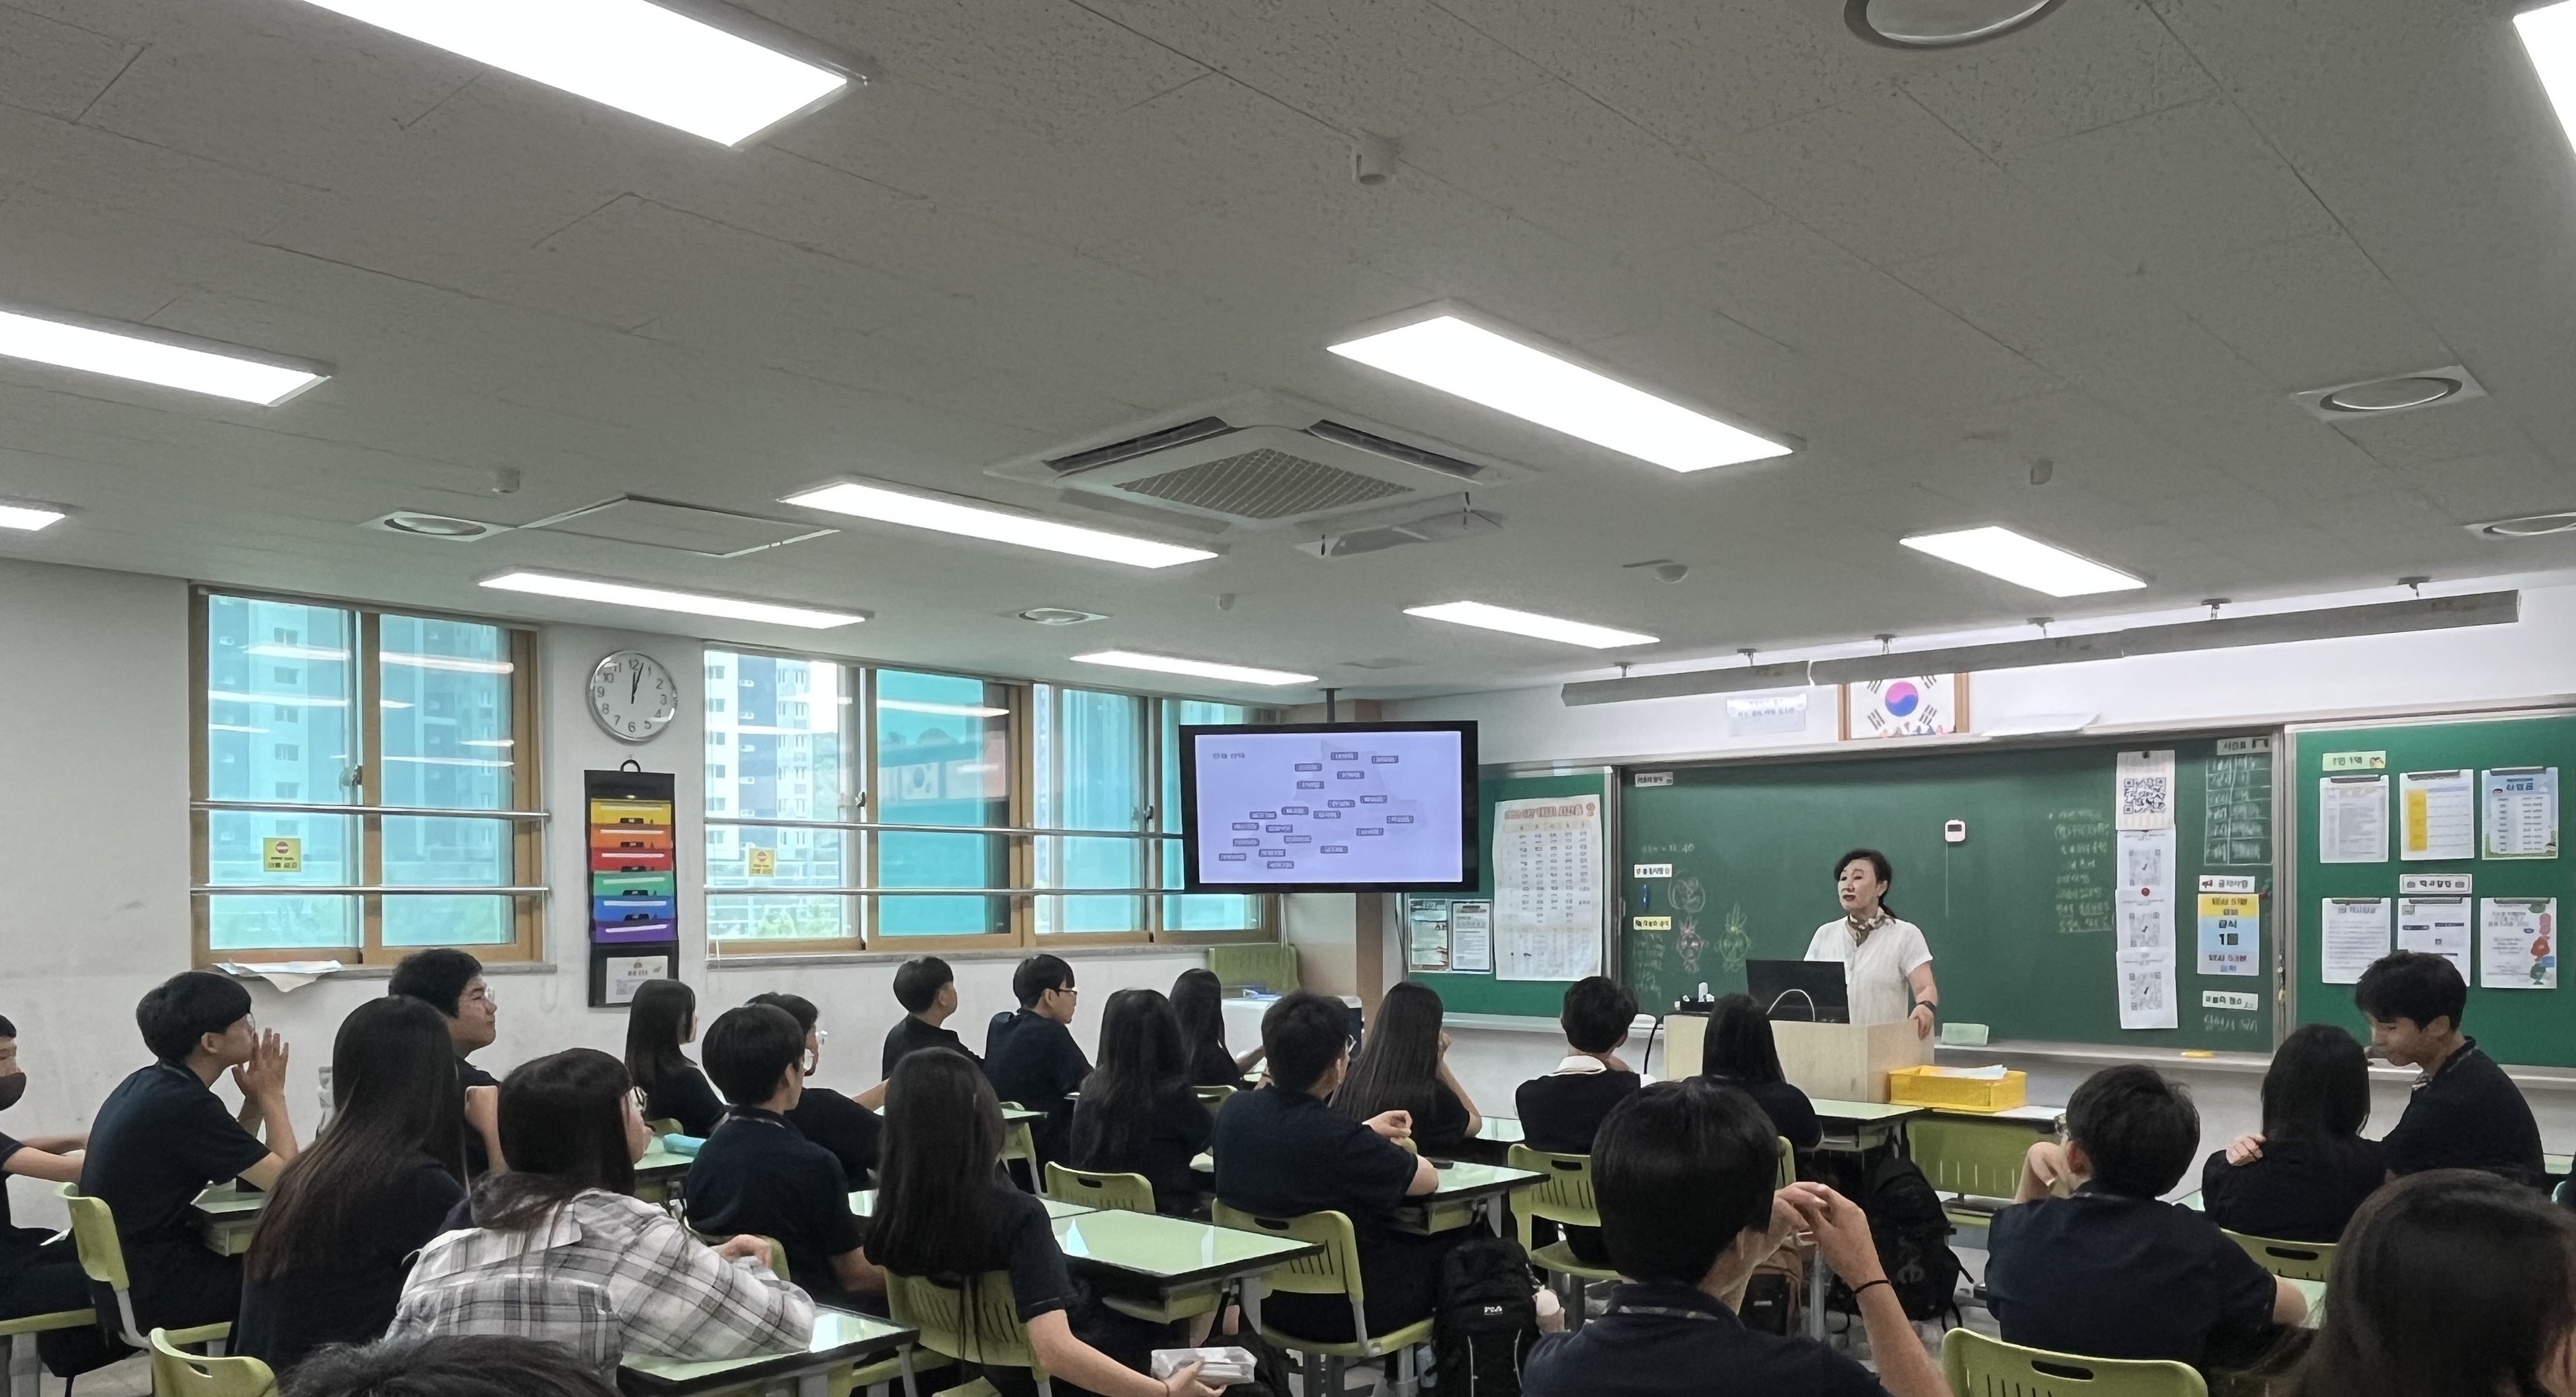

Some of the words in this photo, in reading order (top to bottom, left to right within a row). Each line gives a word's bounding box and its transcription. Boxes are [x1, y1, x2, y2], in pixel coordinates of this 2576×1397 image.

[629, 659, 640, 671] 12
[647, 665, 651, 677] 1
[603, 673, 614, 683] 10
[655, 679, 664, 690] 2
[597, 686, 605, 698] 9
[660, 694, 667, 705] 3
[602, 703, 609, 714] 8
[614, 714, 621, 726] 7
[655, 709, 662, 720] 4
[628, 722, 636, 733] 6
[644, 720, 652, 730] 5
